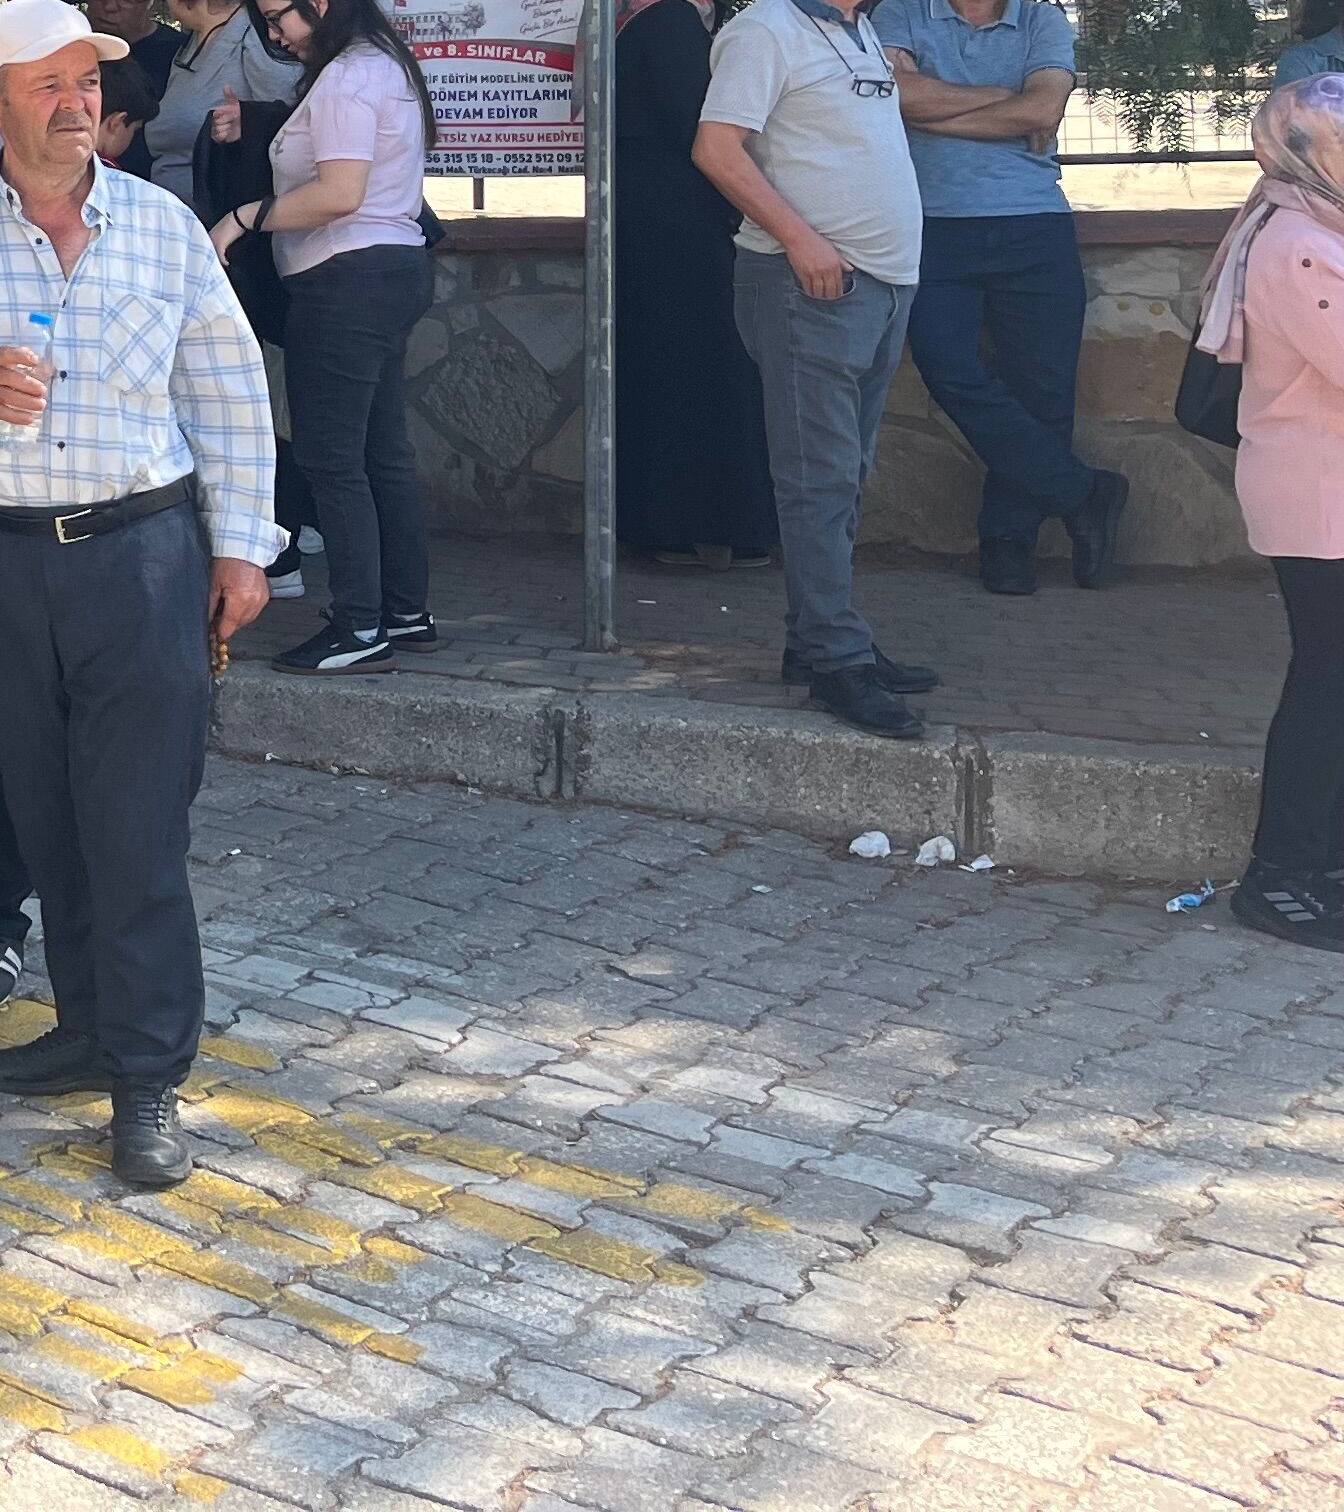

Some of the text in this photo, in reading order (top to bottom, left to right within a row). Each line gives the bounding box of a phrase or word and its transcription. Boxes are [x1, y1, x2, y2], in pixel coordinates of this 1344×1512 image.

[424, 46, 443, 57] ve
[447, 44, 462, 57] 8.
[466, 44, 547, 64] SINIFLAR
[441, 72, 478, 84] EĞİTİM
[480, 71, 535, 84] MODELİNE
[538, 72, 574, 84] UYGUN
[429, 87, 573, 102] DÖNEM KAYITLARIMI
[436, 105, 538, 120] DEVAM EDİYOR
[437, 131, 468, 144] ETSİZ
[470, 133, 492, 144] YAZ
[495, 132, 535, 143] KURSU
[425, 152, 443, 164] 56
[444, 152, 463, 164] 315
[466, 152, 478, 164] 15
[481, 152, 494, 164] 18
[503, 152, 533, 164] 0552
[535, 152, 555, 164] 512
[557, 152, 572, 164] 09
